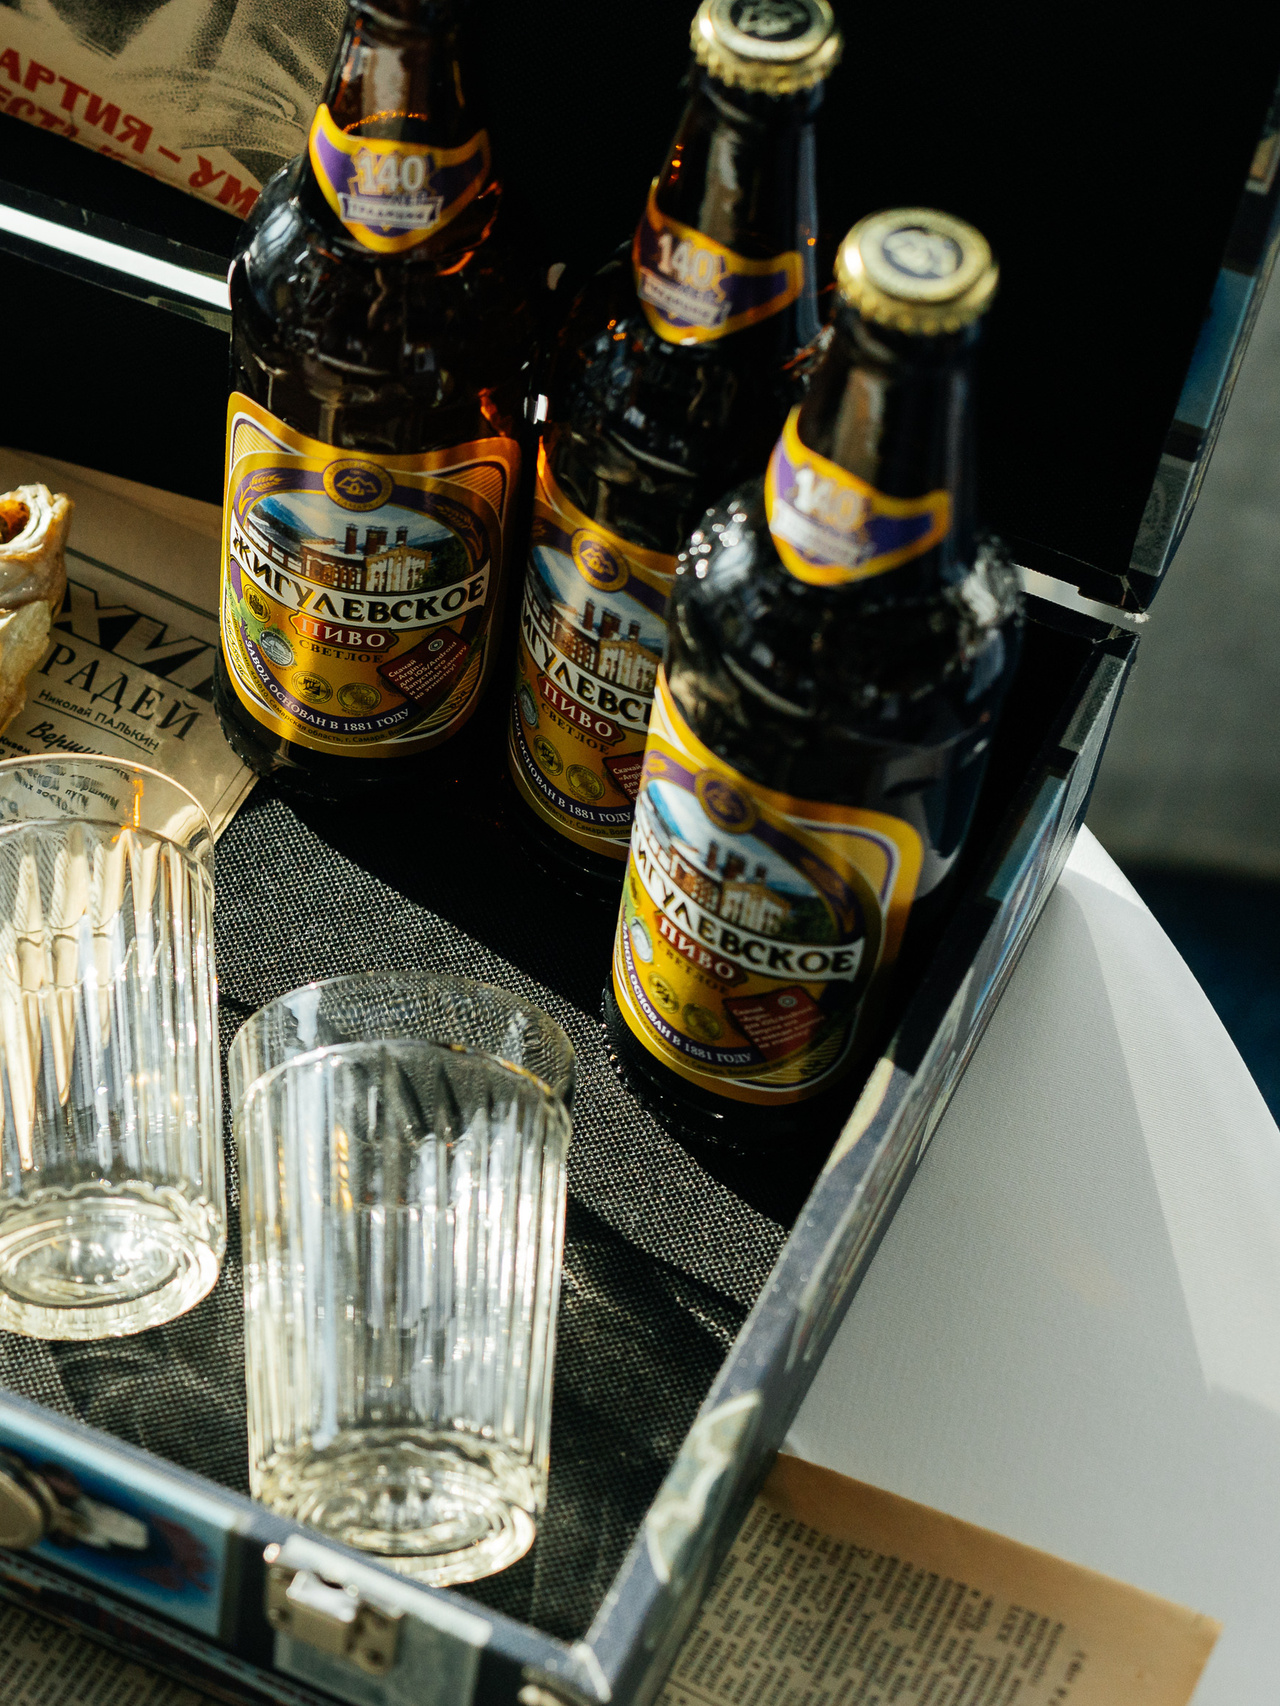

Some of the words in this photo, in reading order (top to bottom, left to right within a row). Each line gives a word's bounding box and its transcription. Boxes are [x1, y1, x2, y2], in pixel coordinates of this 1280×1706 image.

[189, 155, 263, 217] УМ
[358, 153, 426, 193] 140
[657, 233, 715, 291] 140
[232, 529, 485, 624] ЖИГУЛЕВСКОЕ
[299, 640, 384, 664] СВЕТЛОЕ
[301, 617, 386, 648] ПИВО
[245, 640, 271, 684] ЗАВОД
[269, 683, 327, 727] ОСНОВАН
[330, 718, 339, 730] В
[343, 722, 373, 732] 1881
[377, 708, 410, 729] ГОДУ
[389, 659, 417, 678] Скачай
[400, 676, 414, 688] для
[415, 641, 457, 678] iOS/Android
[404, 670, 433, 691] Запусти
[434, 659, 446, 670] его
[416, 670, 443, 688] наведи
[443, 645, 467, 671] камеру
[523, 612, 651, 725] ИГУЛЕВС
[38, 643, 203, 742] РАДЕЙ
[39, 689, 93, 717] Николай
[94, 706, 161, 750] ПАЛЬКИН
[414, 691, 424, 700] на
[542, 681, 613, 738] ПИВО
[308, 727, 344, 743] область,
[540, 701, 611, 756] СВЕТЛОЕ
[520, 740, 557, 799] ОСНОВАН
[558, 796, 566, 808] В
[569, 804, 596, 821] 1881
[598, 811, 632, 823] ГОДУ
[658, 921, 736, 979] ПИВО
[673, 1037, 681, 1050] В
[684, 1042, 713, 1061] 1881
[717, 1049, 752, 1063] ГОДУ
